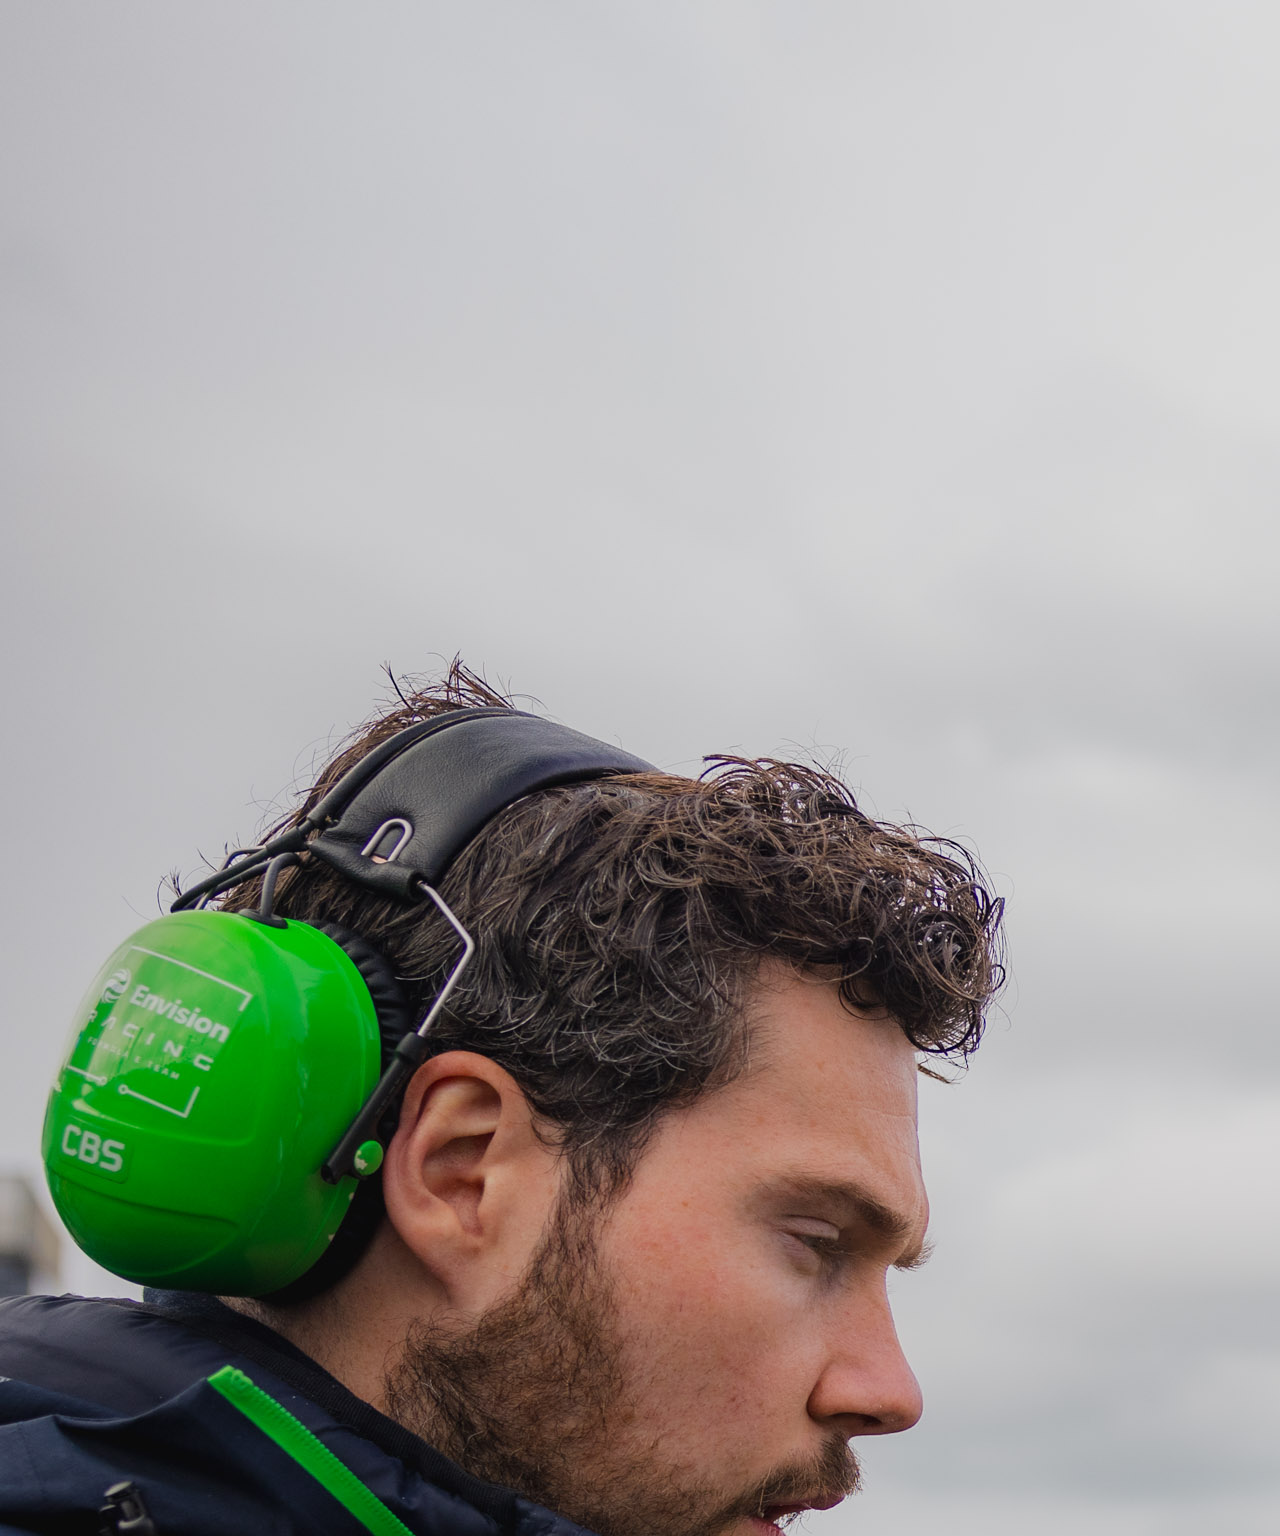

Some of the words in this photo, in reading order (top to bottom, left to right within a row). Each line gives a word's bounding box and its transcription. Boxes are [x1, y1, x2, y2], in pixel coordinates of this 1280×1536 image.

[88, 1009, 215, 1071] RACING
[129, 984, 231, 1043] Envision
[147, 1060, 181, 1080] TEAM
[62, 1124, 126, 1172] CBS
